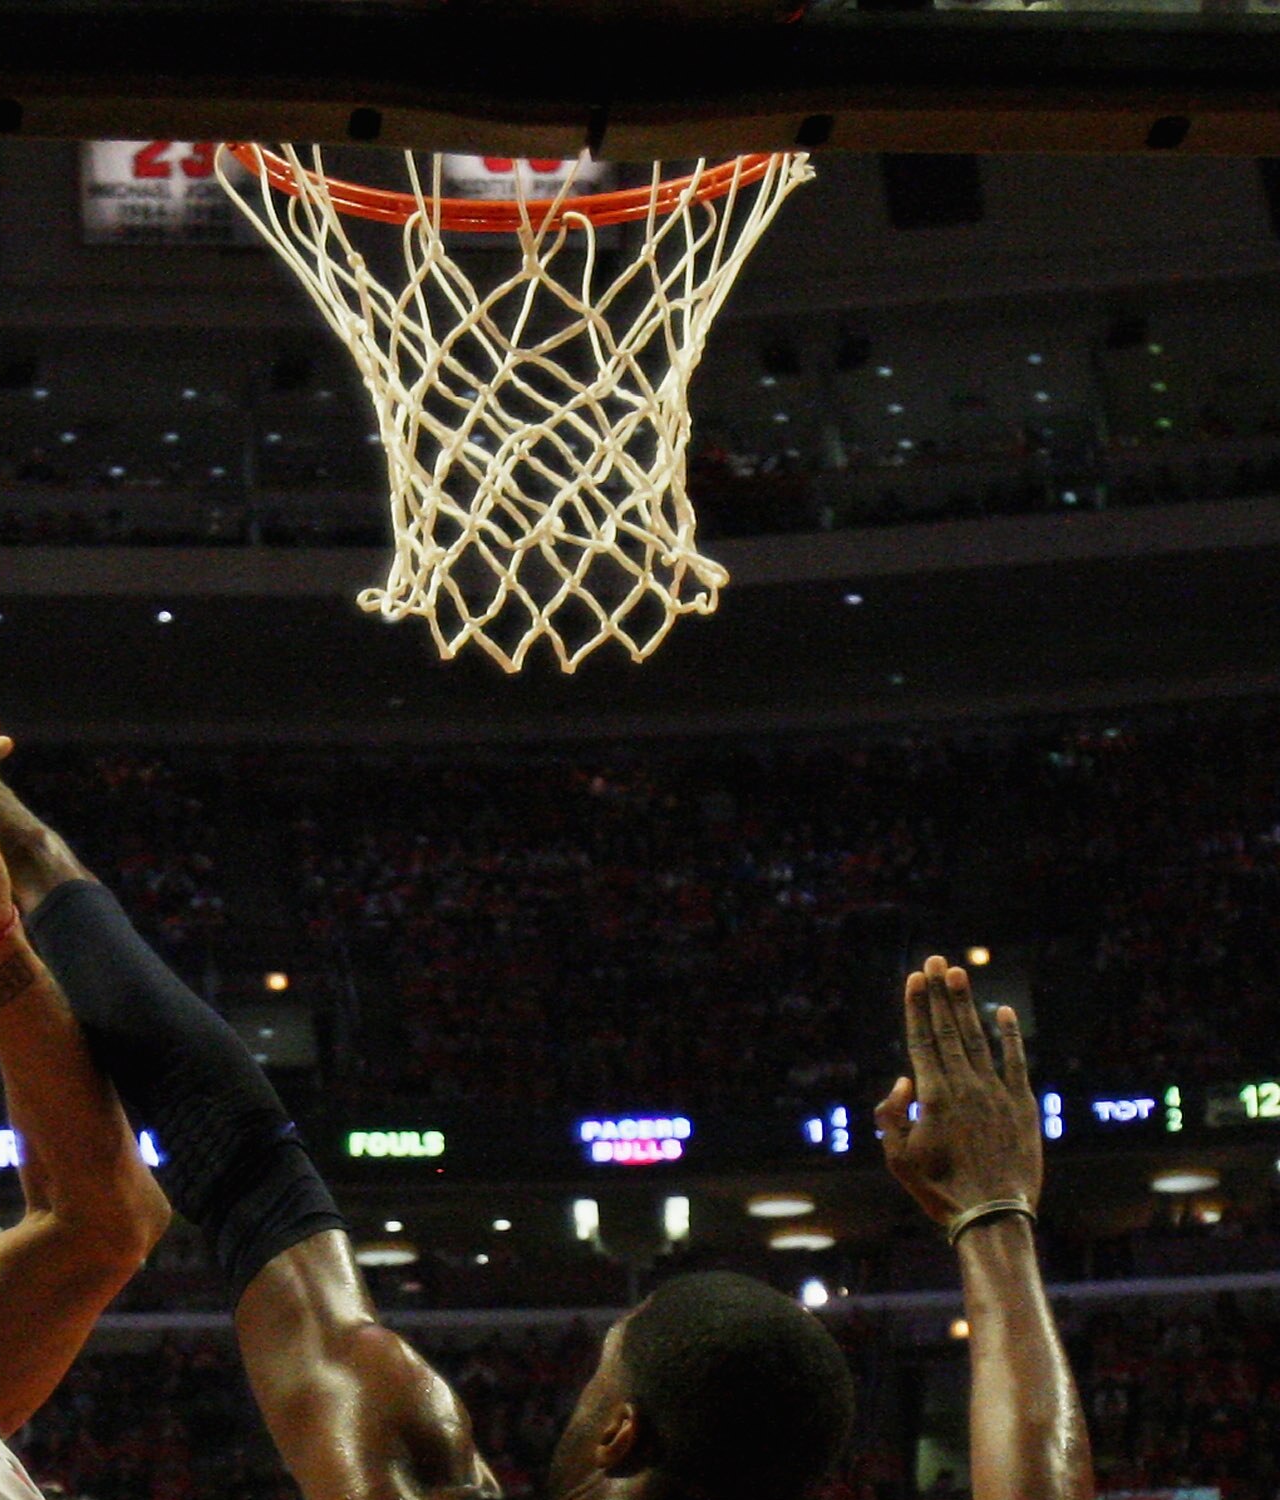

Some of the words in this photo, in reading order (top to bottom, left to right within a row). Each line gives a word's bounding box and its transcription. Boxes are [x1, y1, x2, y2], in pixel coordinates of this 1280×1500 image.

[580, 1116, 691, 1141] PACERS
[348, 1130, 445, 1157] FOULS
[590, 1139, 683, 1163] BULLS
